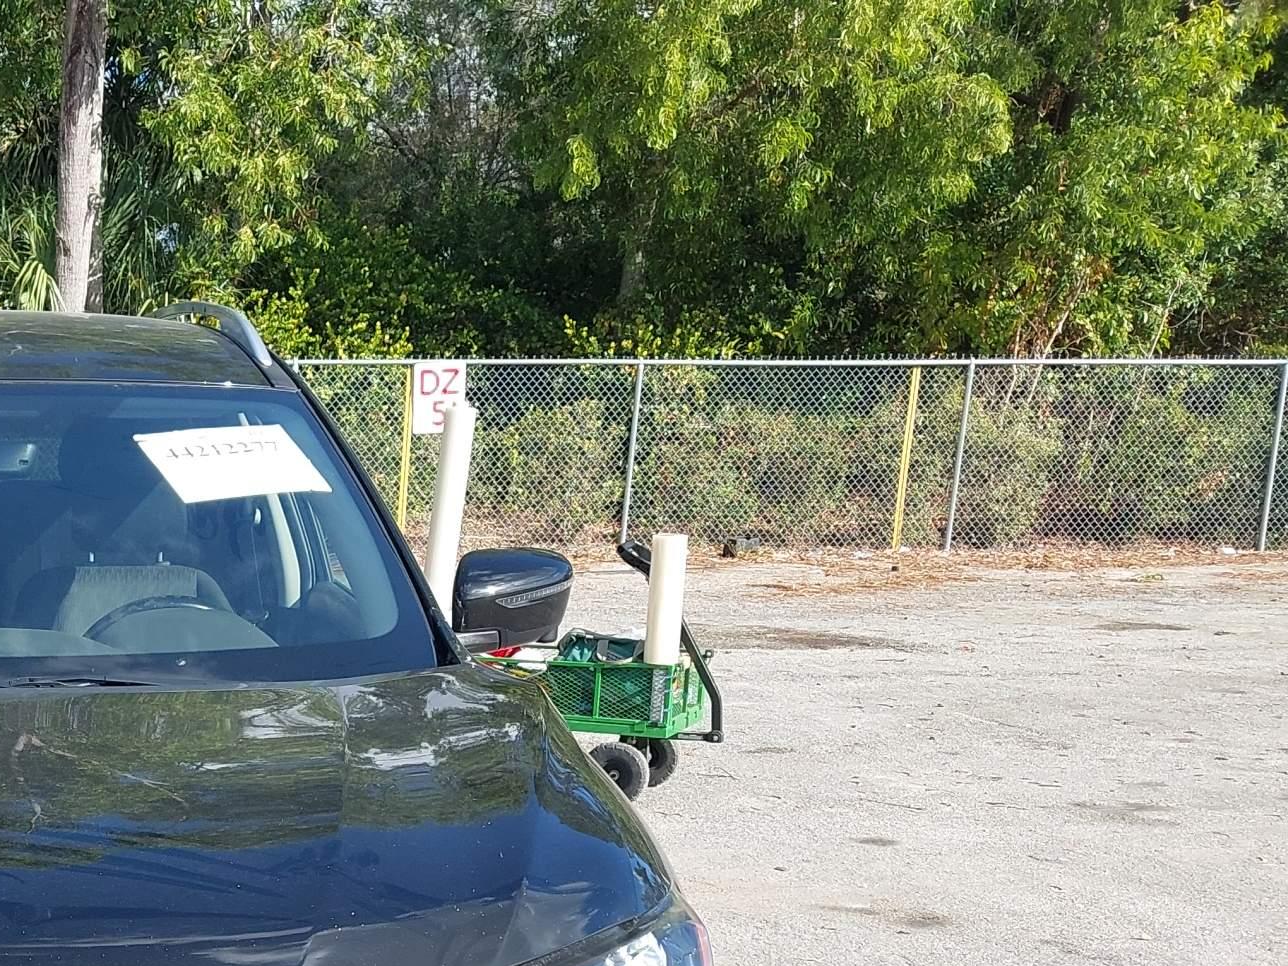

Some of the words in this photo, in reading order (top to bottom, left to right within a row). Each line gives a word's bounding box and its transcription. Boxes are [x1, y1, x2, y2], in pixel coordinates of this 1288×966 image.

[420, 368, 459, 395] DZ
[432, 400, 447, 426] 5
[165, 440, 278, 459] 44212277
